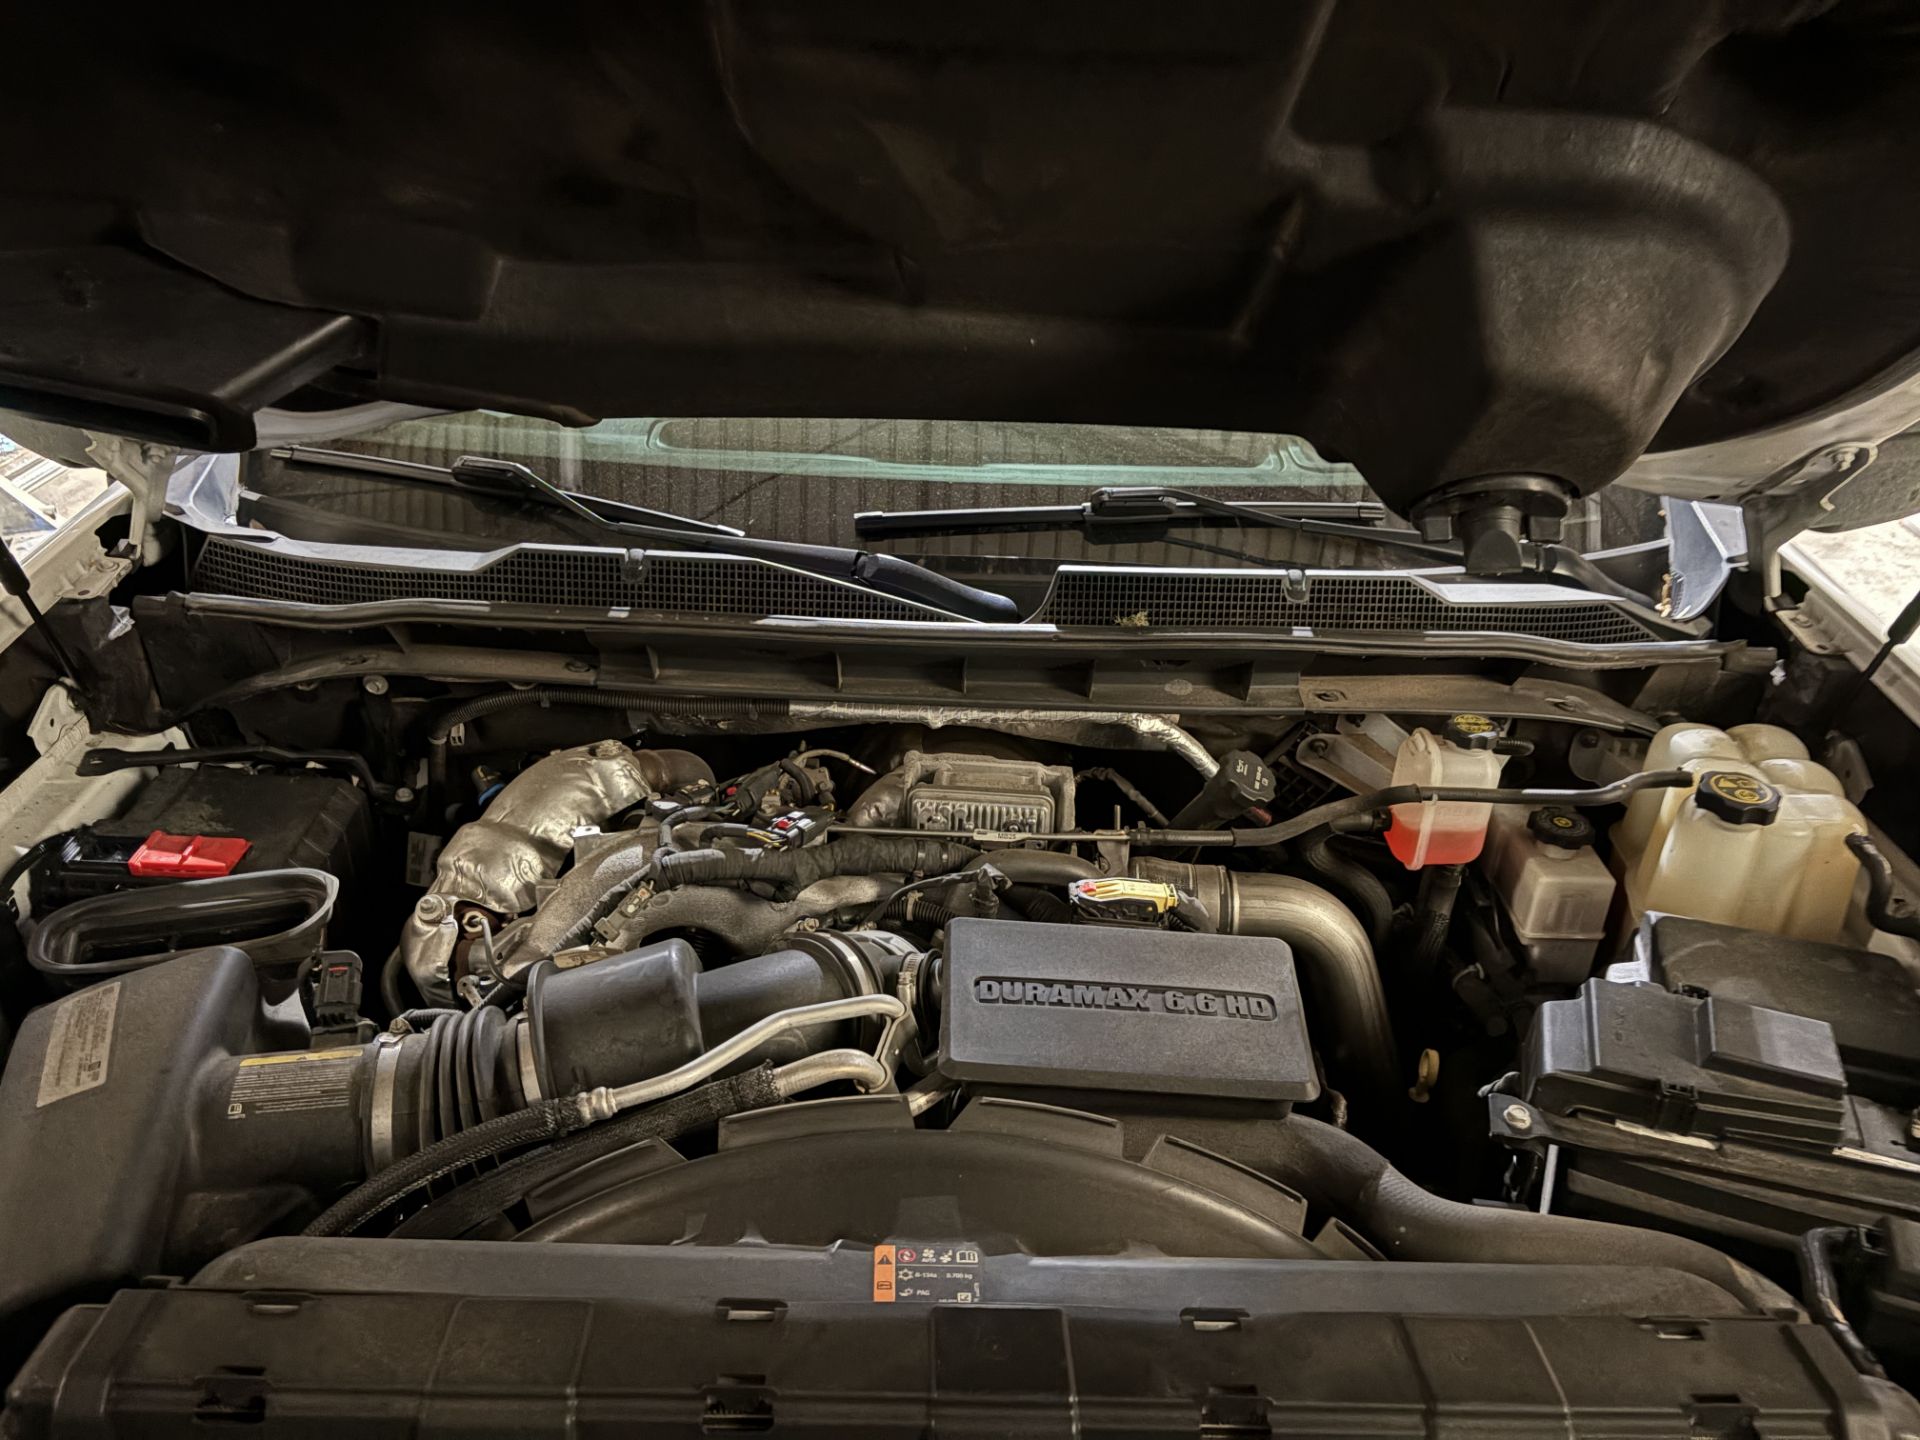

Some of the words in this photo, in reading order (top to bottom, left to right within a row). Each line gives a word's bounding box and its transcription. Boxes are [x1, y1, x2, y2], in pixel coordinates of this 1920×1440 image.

[978, 979, 1150, 1010] DURAMAX
[1164, 990, 1219, 1015] 6.6
[1225, 996, 1274, 1019] HD
